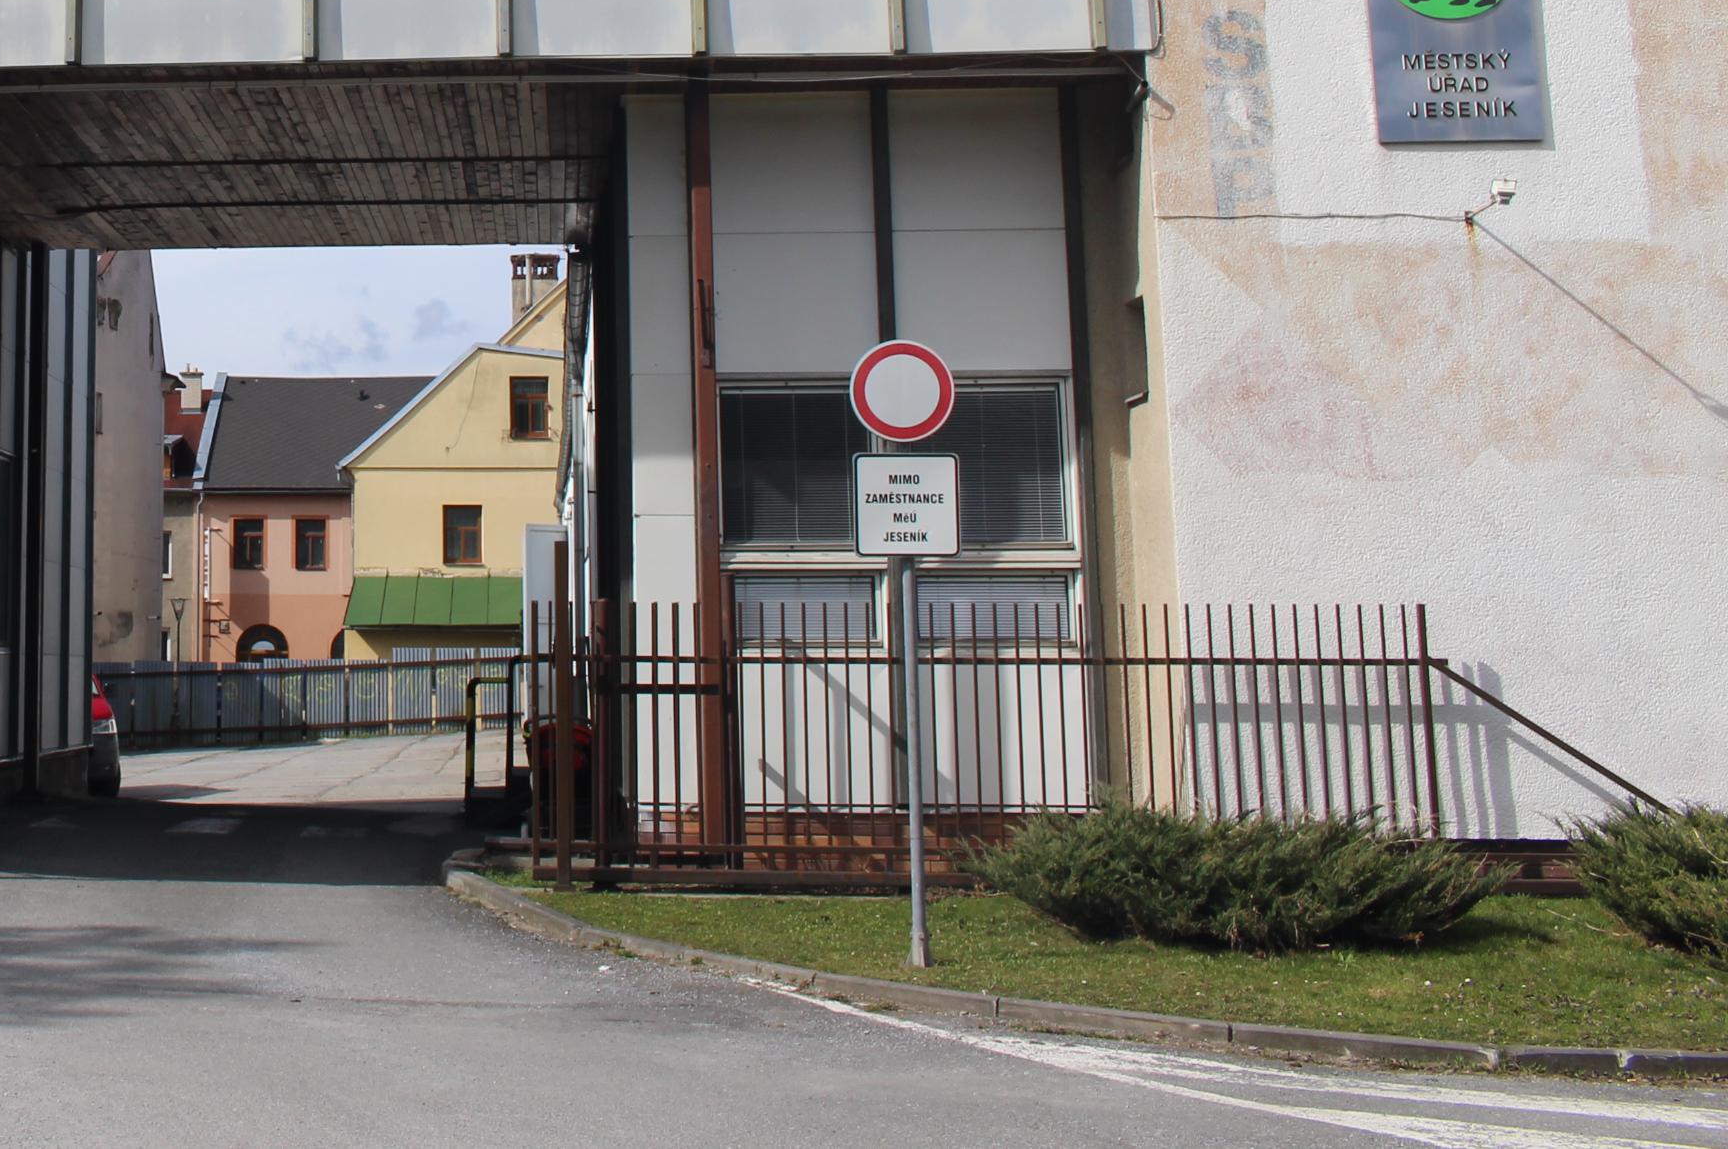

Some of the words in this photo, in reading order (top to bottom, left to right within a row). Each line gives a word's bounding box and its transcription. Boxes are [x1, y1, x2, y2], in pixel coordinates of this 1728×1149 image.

[1401, 48, 1511, 70] MĚSTSKÝ
[1427, 72, 1489, 93] ÚŘAD
[1407, 97, 1517, 118] JESENÍK
[888, 474, 920, 485] MIMO
[865, 490, 945, 504] ZAMĚSTNANCE
[892, 510, 917, 523] MěÚ
[883, 529, 928, 543] JESENÍK
